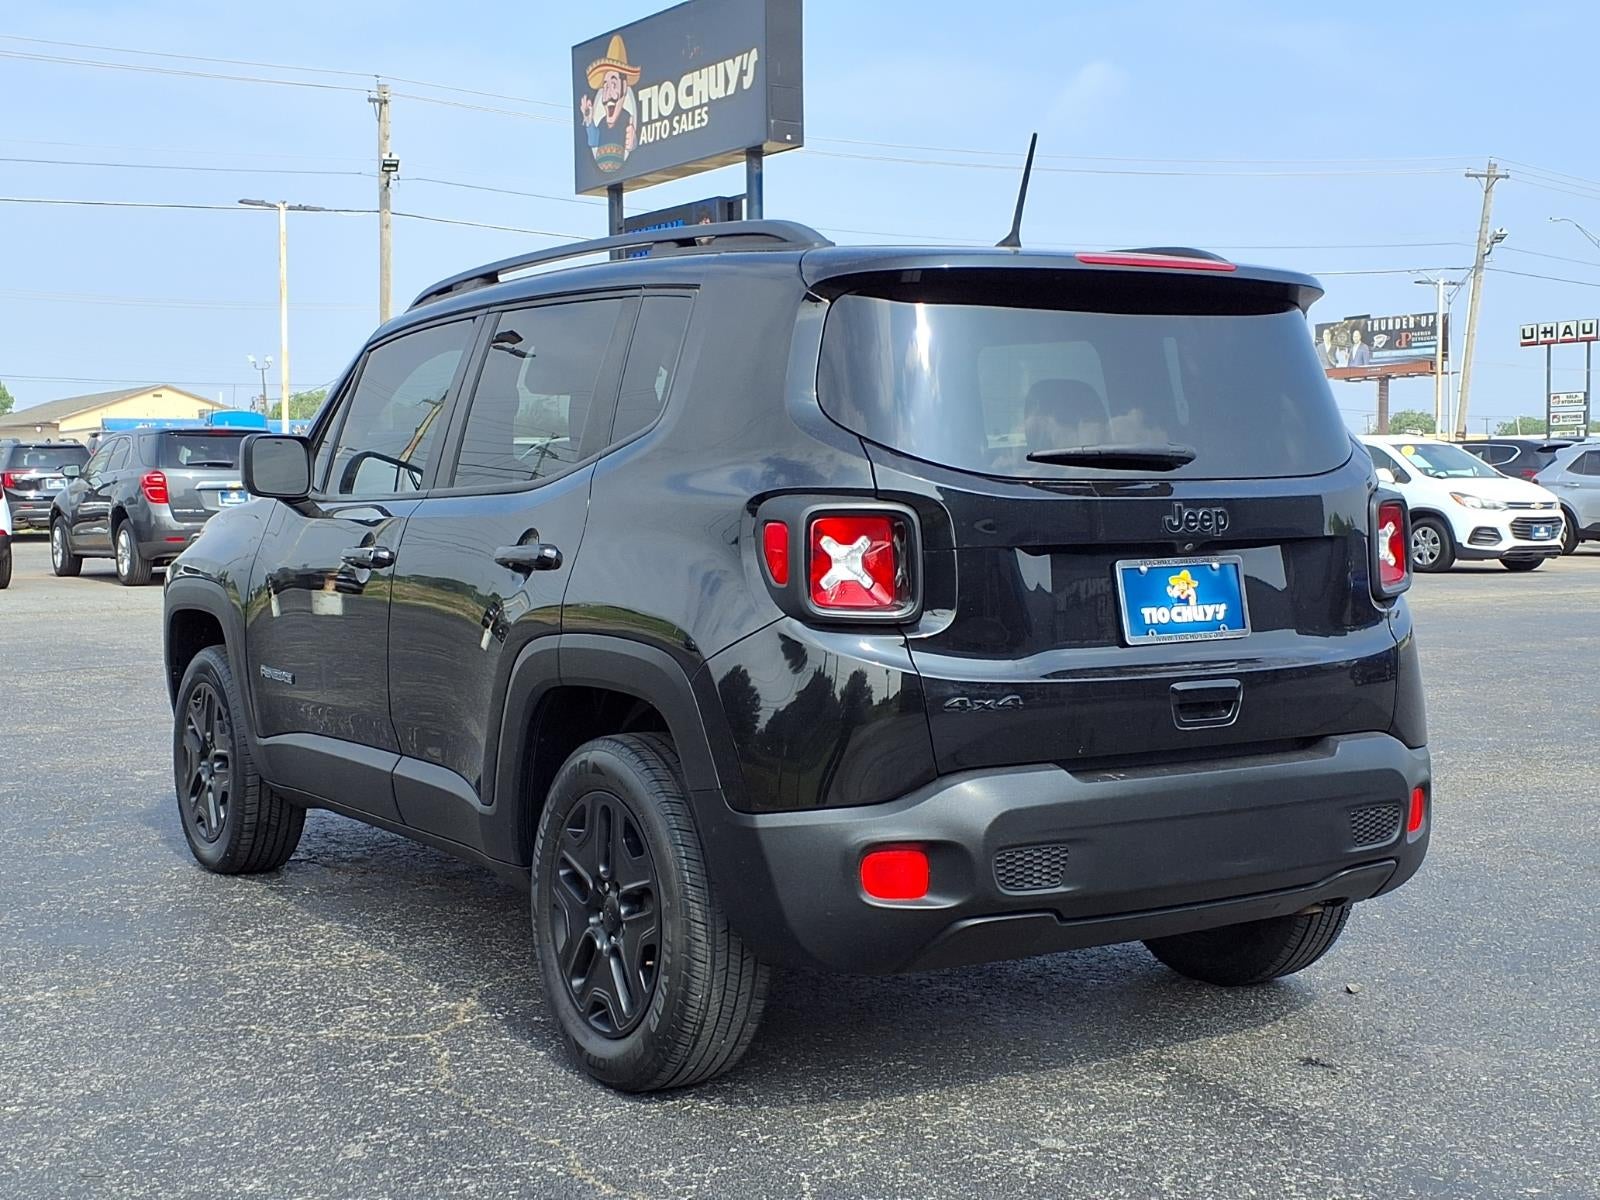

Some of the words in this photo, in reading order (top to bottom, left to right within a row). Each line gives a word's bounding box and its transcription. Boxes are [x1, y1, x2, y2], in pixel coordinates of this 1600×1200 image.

[638, 81, 676, 123] TIO
[678, 48, 758, 110] CHUY'S
[639, 119, 670, 146] AUTO
[672, 106, 708, 135] SALES
[1367, 316, 1415, 332] THUNDER
[1163, 503, 1229, 536] Jeep
[1141, 606, 1170, 624] TIO
[1170, 603, 1227, 623] CHUY'S
[944, 695, 1024, 713] 4x4
